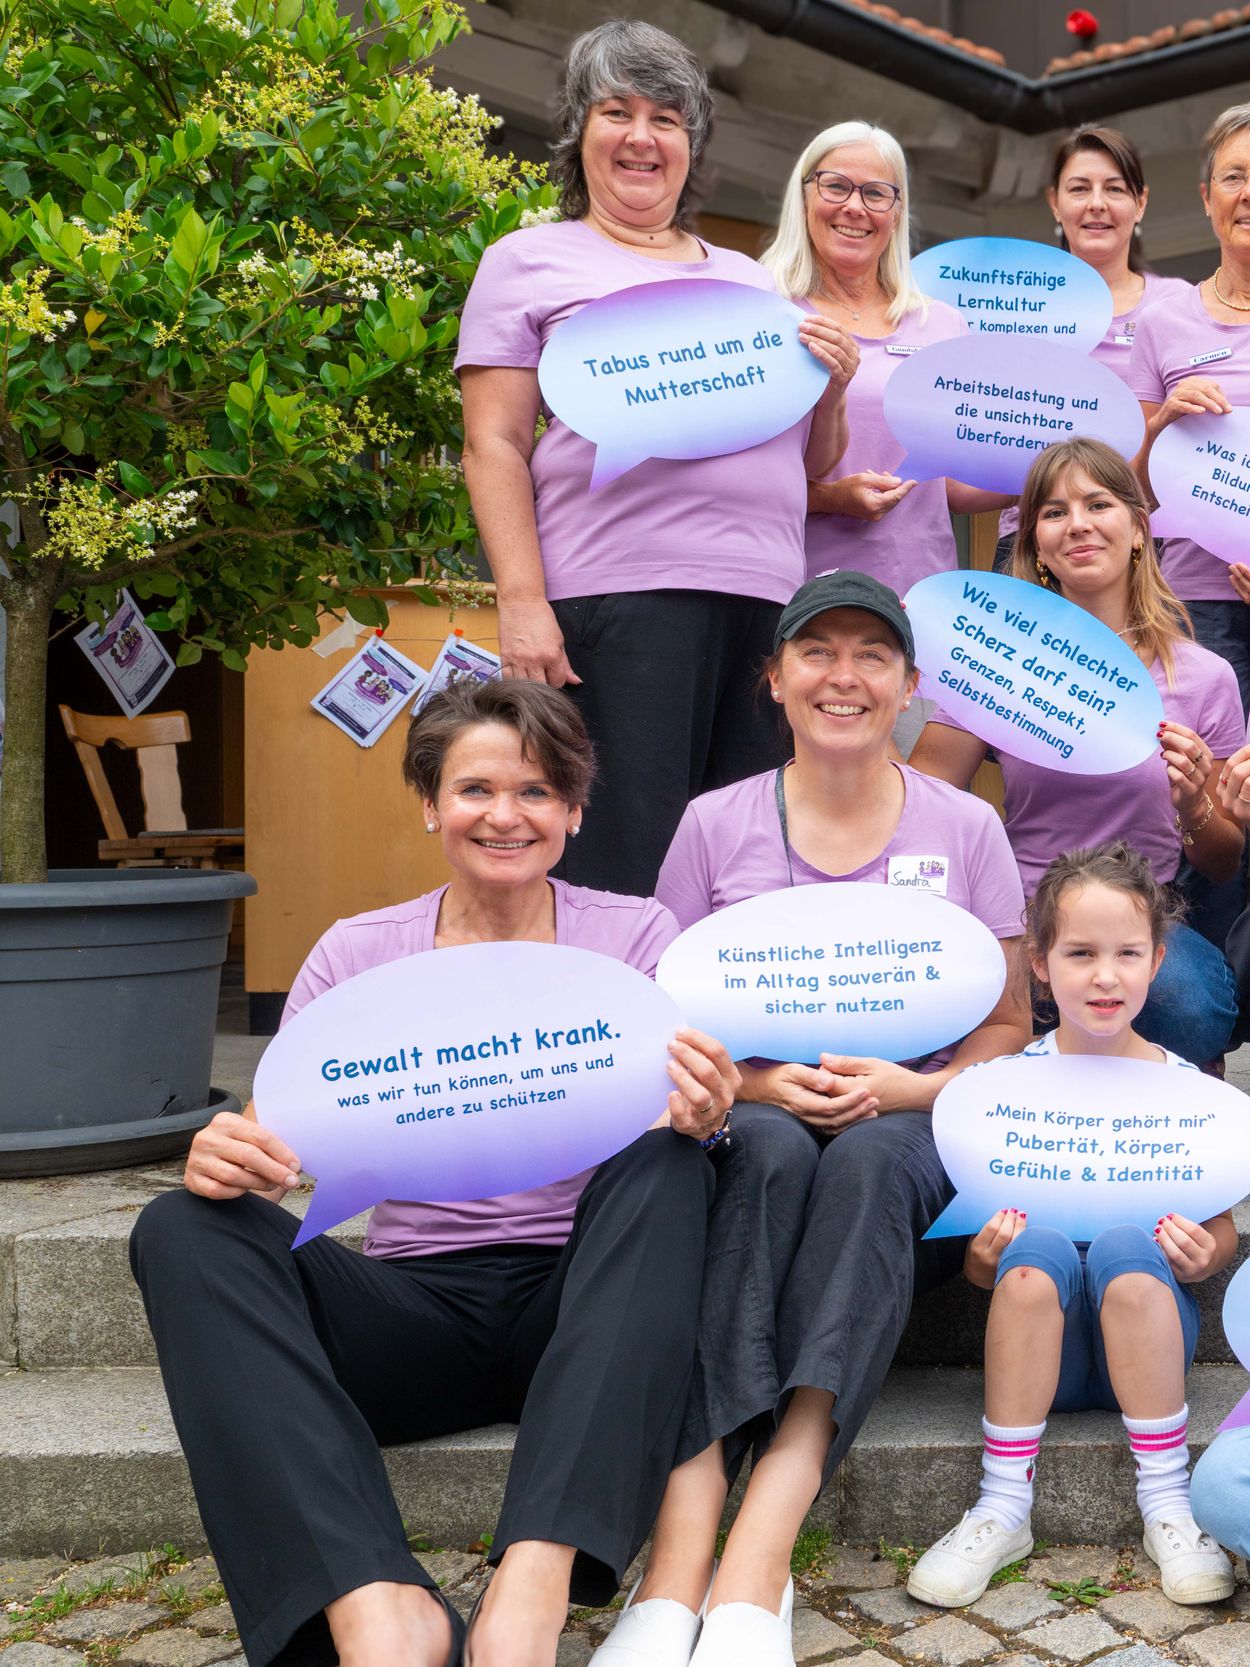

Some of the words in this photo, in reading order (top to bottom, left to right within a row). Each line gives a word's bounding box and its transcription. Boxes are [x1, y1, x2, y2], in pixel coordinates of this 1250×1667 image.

[939, 265, 1066, 292] Zukunftsfähige
[957, 293, 1047, 313] Lernkultur
[979, 319, 1048, 334] komplexen
[1053, 322, 1077, 335] und
[583, 354, 650, 377] Tabus
[657, 340, 707, 366] rund
[714, 339, 745, 356] um
[752, 330, 783, 350] die
[624, 365, 765, 407] Mutterschaft
[934, 375, 1065, 411] Arbeitsbelastung
[1071, 398, 1099, 411] und
[954, 402, 978, 418] die
[984, 409, 1074, 431] unsichtbare
[956, 424, 1050, 451] Überforderu
[1195, 440, 1237, 463] „Was
[962, 581, 998, 614] Wie
[1004, 609, 1038, 637] viel
[1040, 632, 1139, 693] schlechter
[952, 614, 1017, 662] Scherz
[1021, 656, 1067, 687] darf
[1067, 683, 1116, 717] sein?
[950, 646, 1015, 695] Grenzen,
[1021, 686, 1086, 735] Respekt,
[938, 669, 1074, 760] Selbstbestimmung
[890, 870, 932, 888] Sandra
[718, 945, 825, 963] Künstliche
[834, 938, 943, 960] Intelligenz
[724, 974, 747, 989] im
[756, 973, 820, 993] Alltag
[828, 966, 916, 987] souverän
[925, 965, 941, 981] &
[765, 999, 827, 1015] sicher
[835, 996, 905, 1014] nutzen
[321, 1046, 423, 1082] Gewalt
[436, 1031, 523, 1066] macht
[535, 1018, 621, 1051] krank.
[337, 1093, 370, 1108] was
[377, 1086, 405, 1102] wir
[413, 1082, 441, 1097] tun
[448, 1073, 513, 1092] können,
[520, 1067, 544, 1080] um
[551, 1062, 578, 1076] uns
[585, 1053, 614, 1070] und
[395, 1106, 456, 1125] andere
[462, 1102, 483, 1115] zu
[490, 1089, 566, 1111] schützen
[985, 1103, 1037, 1122] „Mein
[1044, 1110, 1105, 1131] Körper
[1111, 1115, 1171, 1133] gehört
[1179, 1113, 1216, 1128] mir“
[1005, 1131, 1105, 1157] Pubertät,
[1114, 1139, 1190, 1159] Körper,
[988, 1158, 1071, 1181] Gefühle
[1081, 1166, 1097, 1182] &
[1106, 1165, 1204, 1182] Identität
